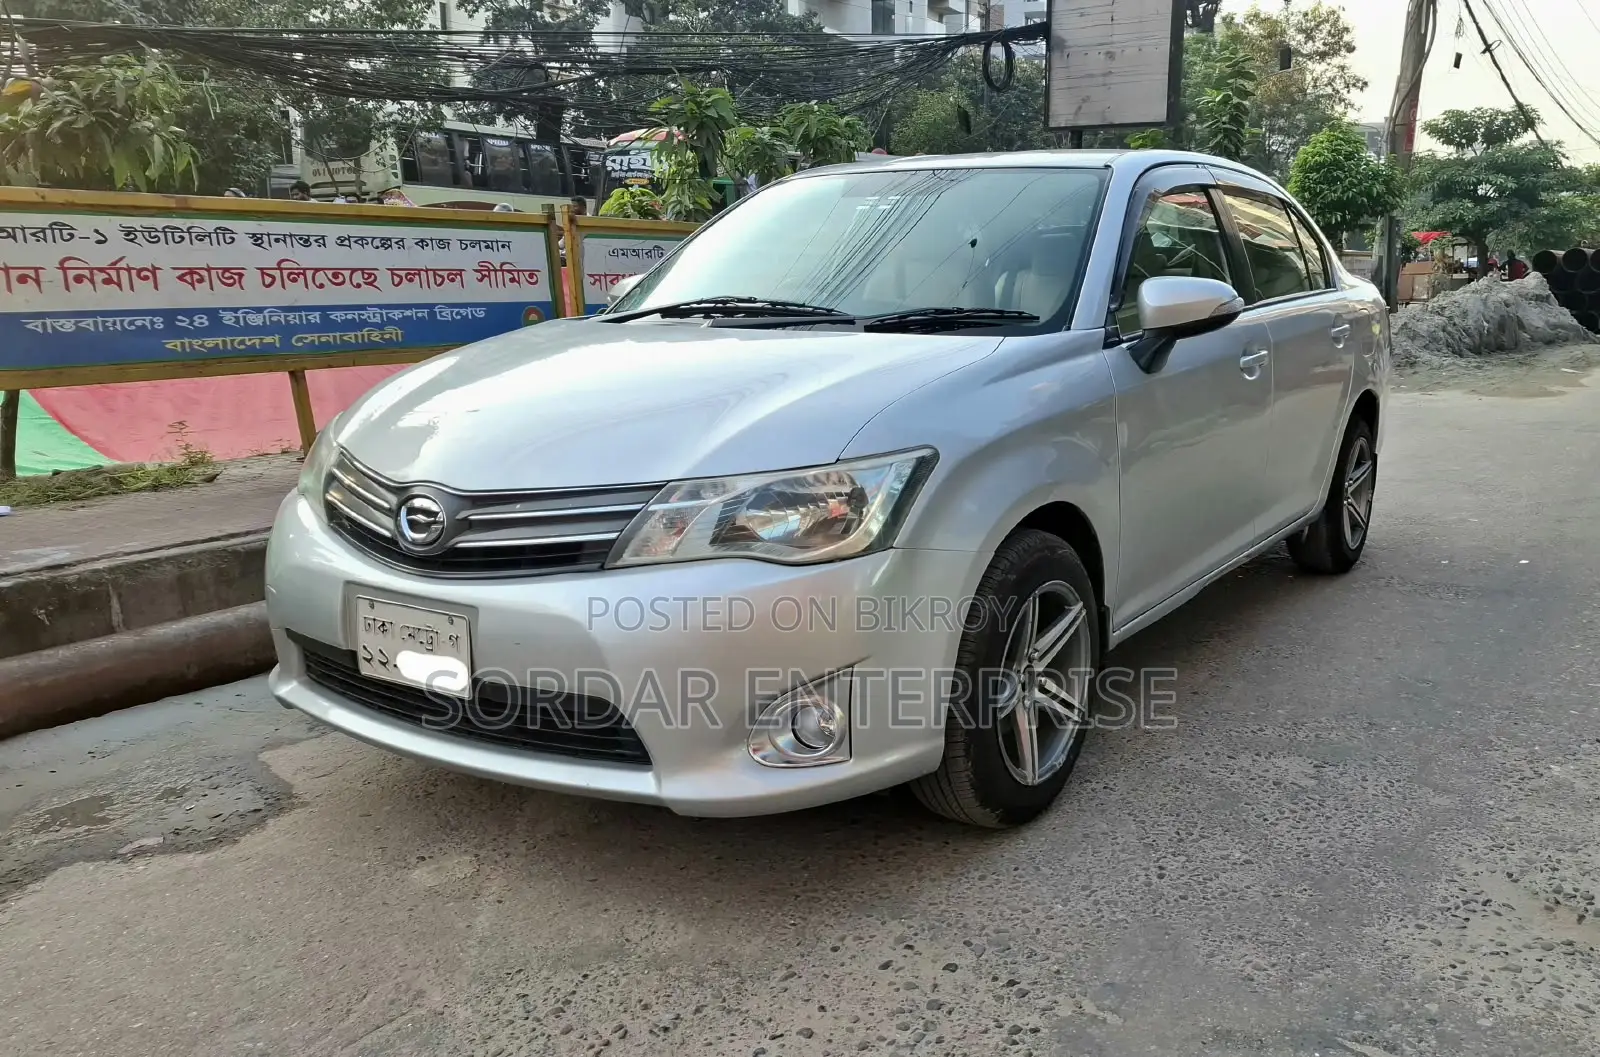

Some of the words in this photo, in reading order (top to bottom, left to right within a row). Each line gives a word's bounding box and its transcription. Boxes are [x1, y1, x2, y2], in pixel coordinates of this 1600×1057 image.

[118, 223, 239, 248] ইউটিলিটি
[244, 231, 329, 251] স্থানান্তর
[335, 234, 407, 252] প্রকল্পের
[413, 237, 453, 252] কাজ
[456, 238, 513, 253] চলমান
[608, 244, 666, 261] এমআরটি
[54, 255, 164, 293] নির্মাণ
[169, 262, 248, 292] কাজ
[254, 258, 382, 293] চলিতেছে
[386, 265, 467, 290] চলাচল
[472, 260, 542, 289] সীমিত
[174, 314, 210, 331] ২৪
[433, 304, 487, 321] ব্রিগেড
[162, 333, 282, 353] বাংলাদেশ
[291, 325, 405, 349] সেনাবাহিনী
